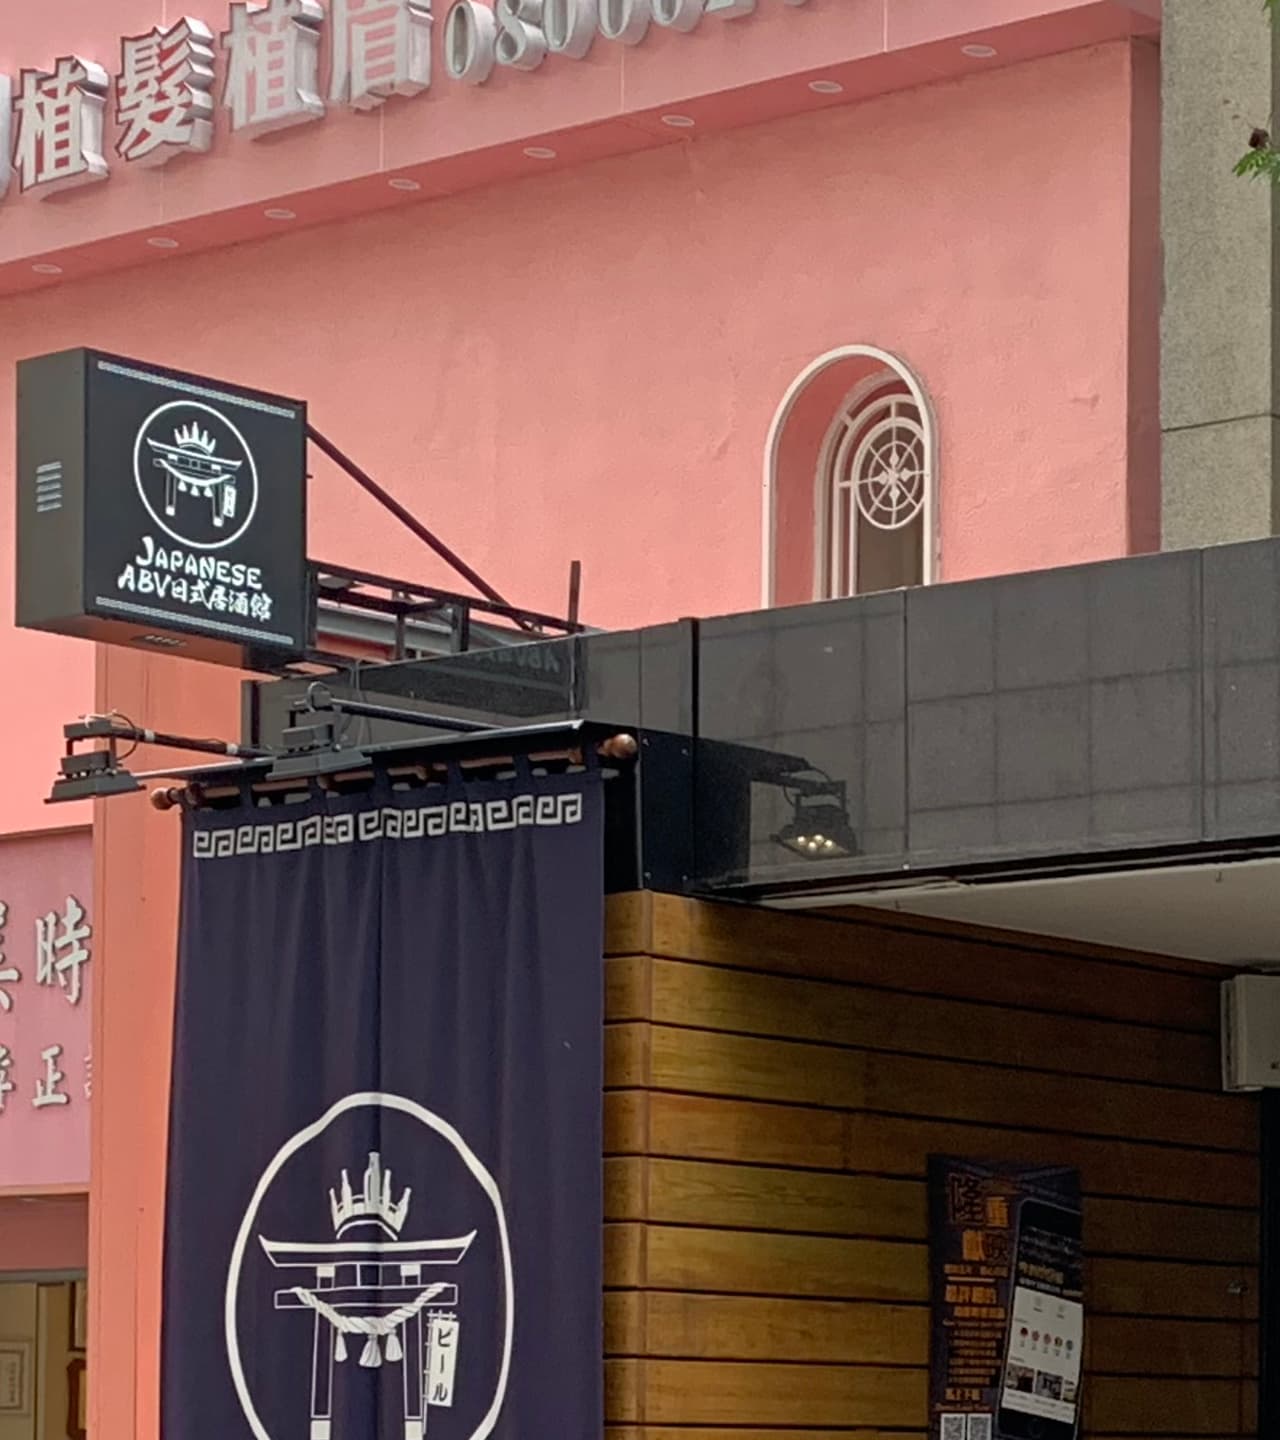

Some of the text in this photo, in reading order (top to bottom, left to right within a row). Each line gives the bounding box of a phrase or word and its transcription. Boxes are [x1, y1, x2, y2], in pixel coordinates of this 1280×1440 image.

[135, 535, 263, 590] JAPANESE
[117, 563, 273, 622] ABV日式居酒館
[430, 1326, 454, 1402] ビール
